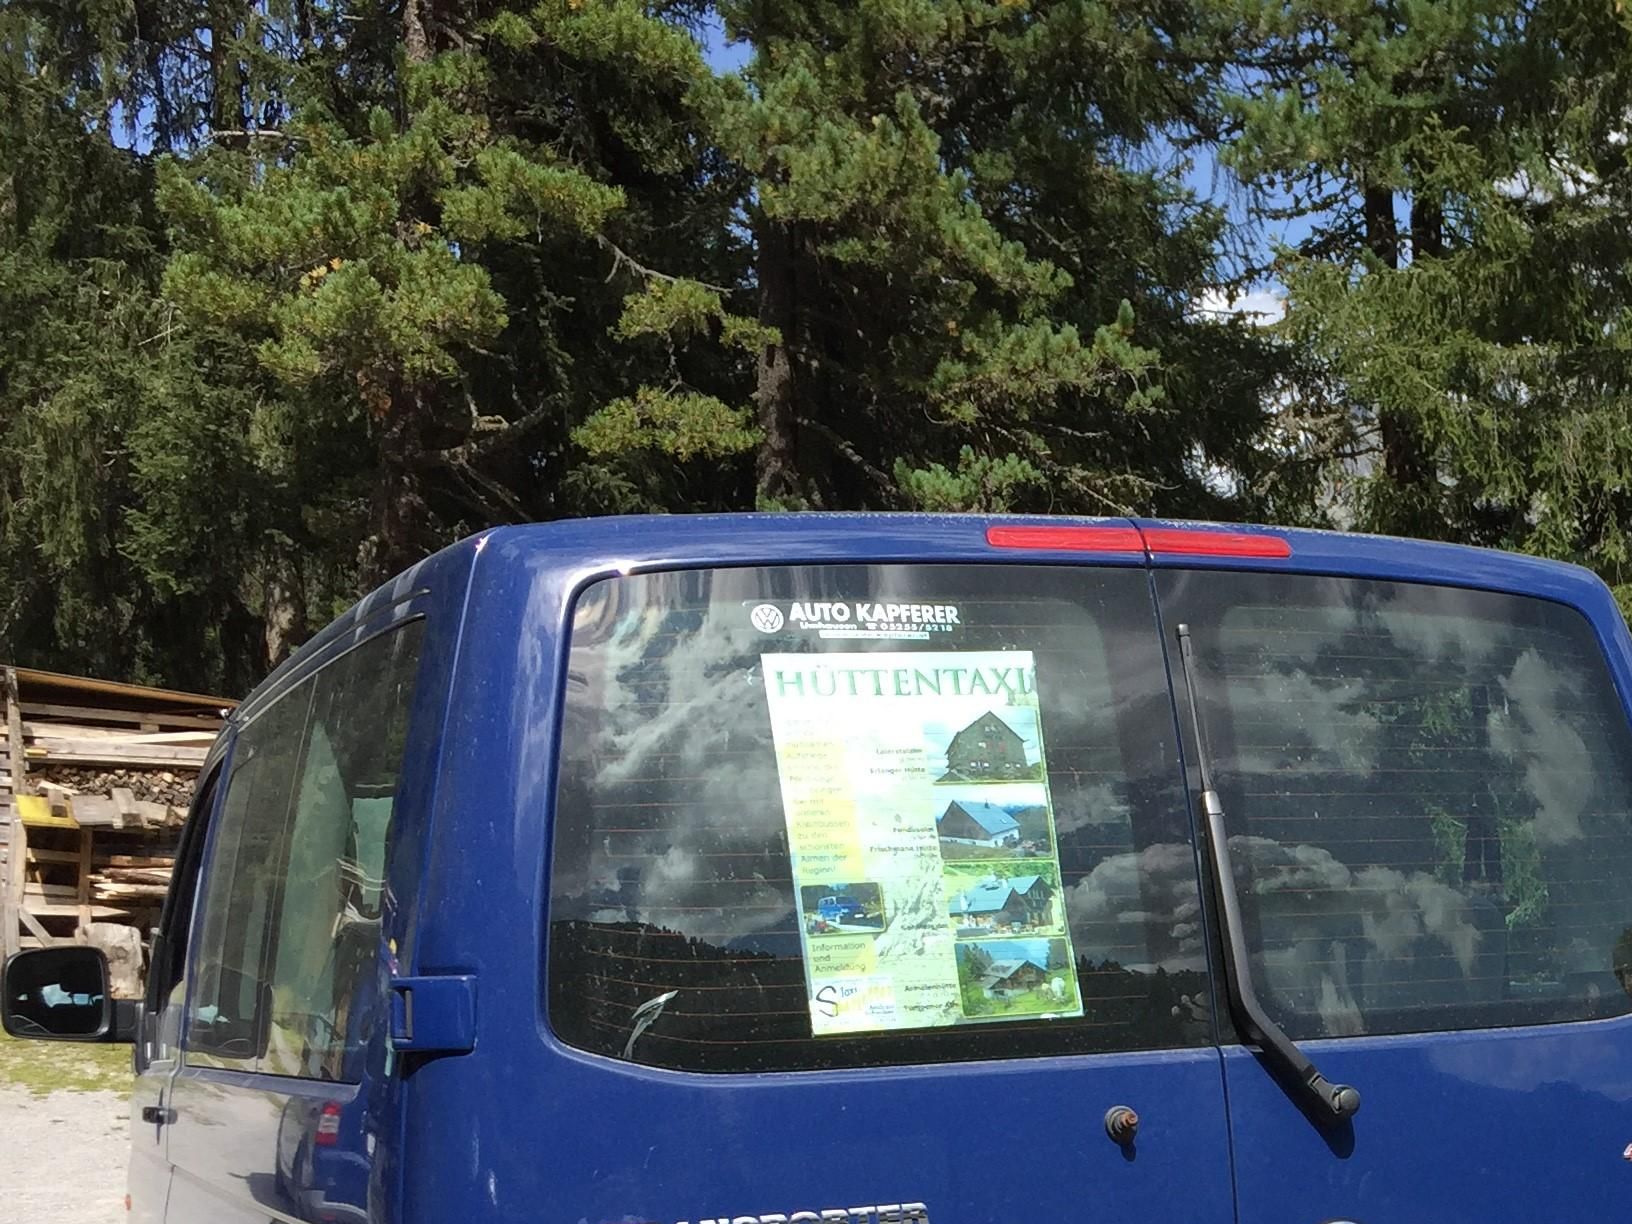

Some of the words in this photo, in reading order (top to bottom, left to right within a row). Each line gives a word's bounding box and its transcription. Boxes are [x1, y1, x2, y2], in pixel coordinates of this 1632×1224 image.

[789, 602, 850, 622] AUTO
[855, 603, 960, 625] KAPFERER
[775, 664, 1034, 697] HÜTTENTAXI
[812, 941, 866, 952] Information
[813, 953, 832, 963] und
[815, 962, 867, 973] Anmeldung
